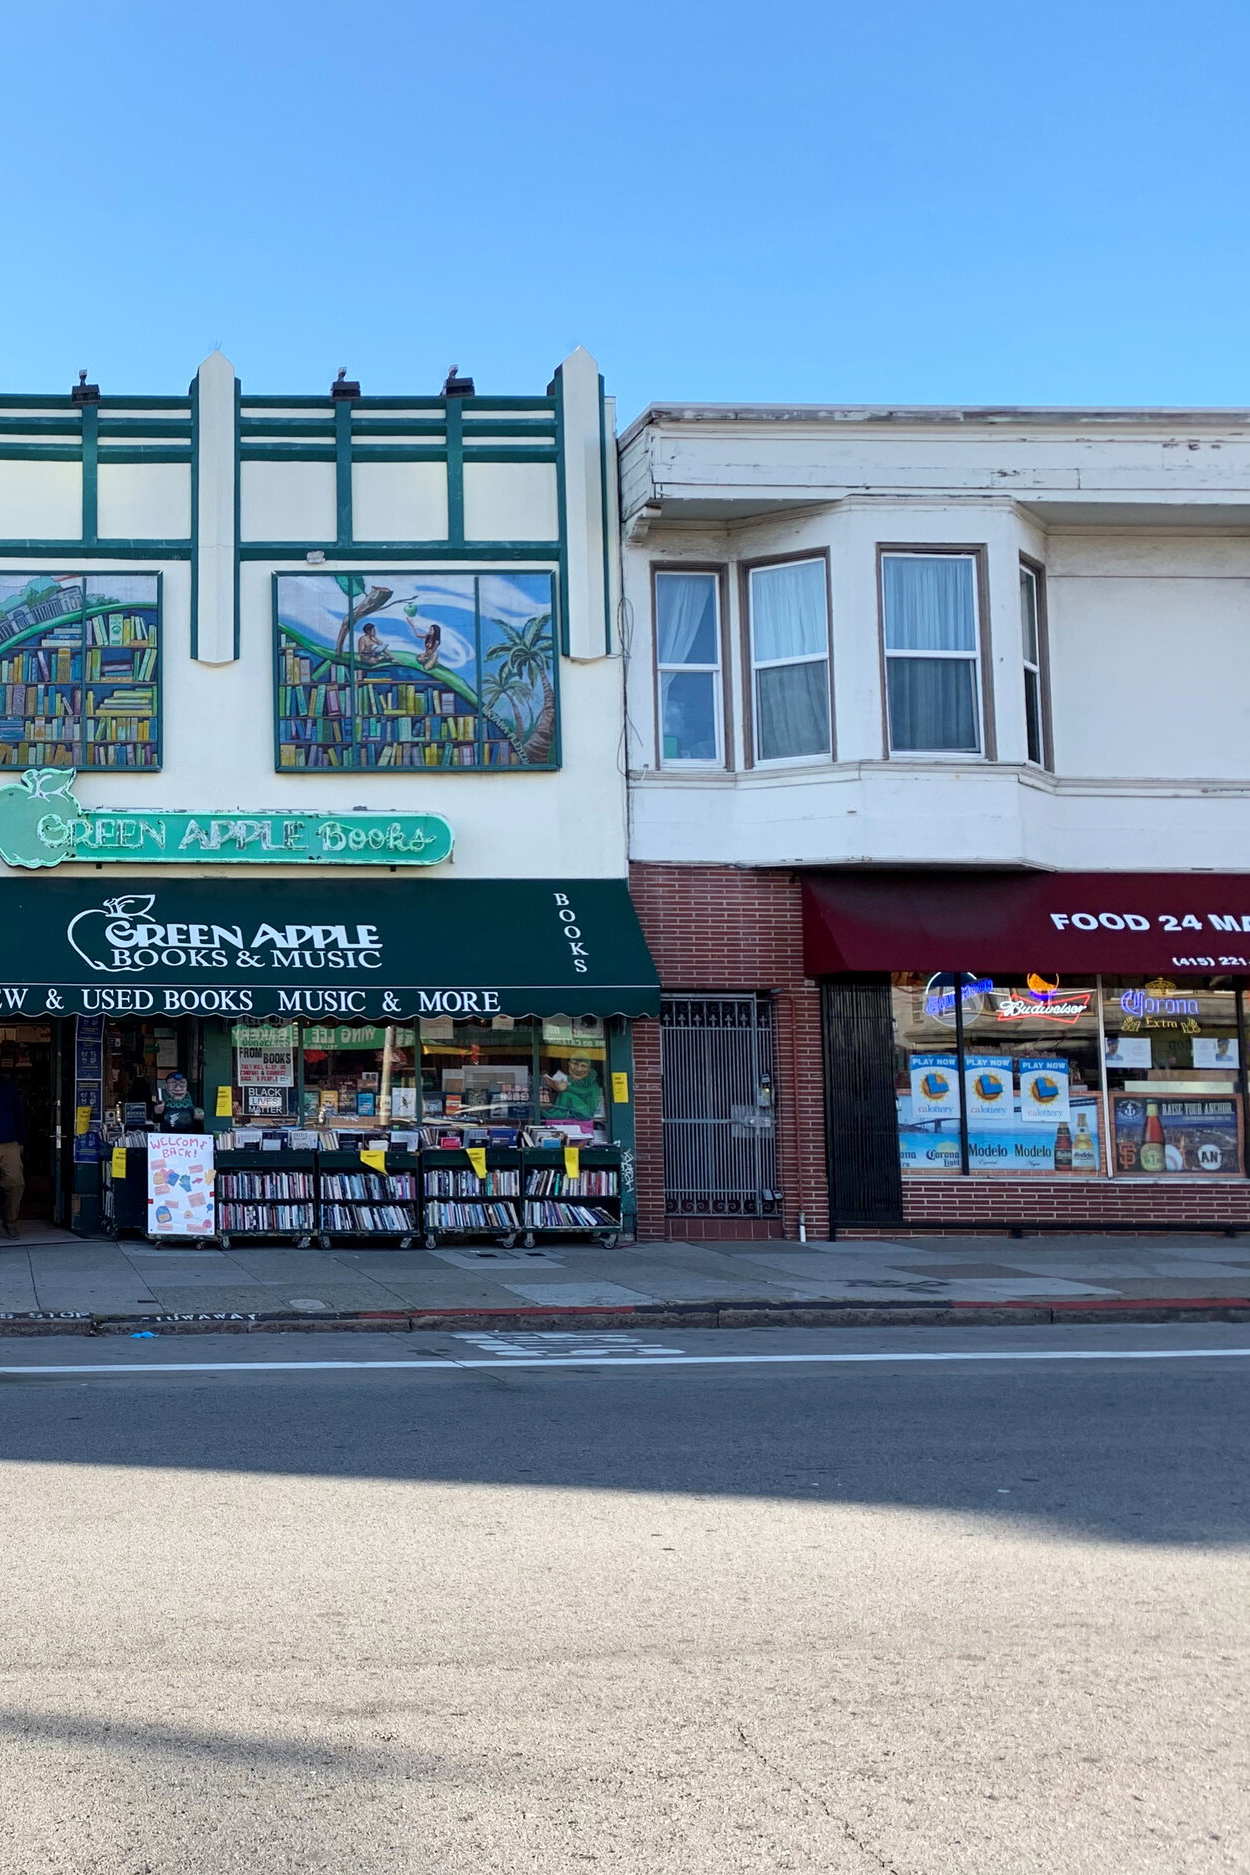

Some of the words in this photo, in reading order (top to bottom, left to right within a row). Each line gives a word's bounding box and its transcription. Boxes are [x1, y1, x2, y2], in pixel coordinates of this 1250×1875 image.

[36, 813, 167, 850] GREEN
[178, 818, 309, 850] APPLE
[316, 818, 436, 853] Books
[1050, 913, 1150, 931] FOOD
[1158, 914, 1203, 931] 24
[105, 920, 244, 949] GREEN
[250, 922, 383, 949] APPLE
[554, 892, 590, 973] BOOKS
[111, 949, 229, 967] BOOKS
[236, 950, 265, 967] &
[271, 950, 383, 968] MUSIC
[1172, 957, 1216, 967] (415)
[45, 988, 65, 1010] &
[81, 989, 154, 1011] USED
[163, 989, 253, 1011] BOOKS
[277, 990, 366, 1012] MUSIC
[381, 991, 402, 1012] &
[418, 991, 501, 1013] MORE
[1120, 989, 1199, 1017] Corona
[999, 1000, 1088, 1016] Budweiser
[1146, 1017, 1178, 1029] Extra
[239, 1047, 263, 1058] FROM
[263, 1053, 291, 1064] BOOKS
[912, 1057, 934, 1066] PLAY
[937, 1058, 956, 1066] NOW
[966, 1058, 988, 1067] PLAY
[991, 1059, 1010, 1067] NOW
[1022, 1061, 1043, 1069] PLAY
[248, 1088, 282, 1097] BLACK
[251, 1097, 279, 1105] LIVES
[248, 1106, 283, 1114] MATTER
[918, 1105, 954, 1115] calottery
[971, 1105, 1007, 1115] calottery
[1028, 1108, 1063, 1119] calottery
[150, 1137, 207, 1150] WELCOME
[162, 1147, 198, 1158] BACK!
[968, 1143, 1008, 1158] Modelo
[1015, 1144, 1052, 1157] Modelo
[28, 1311, 91, 1319] STOP
